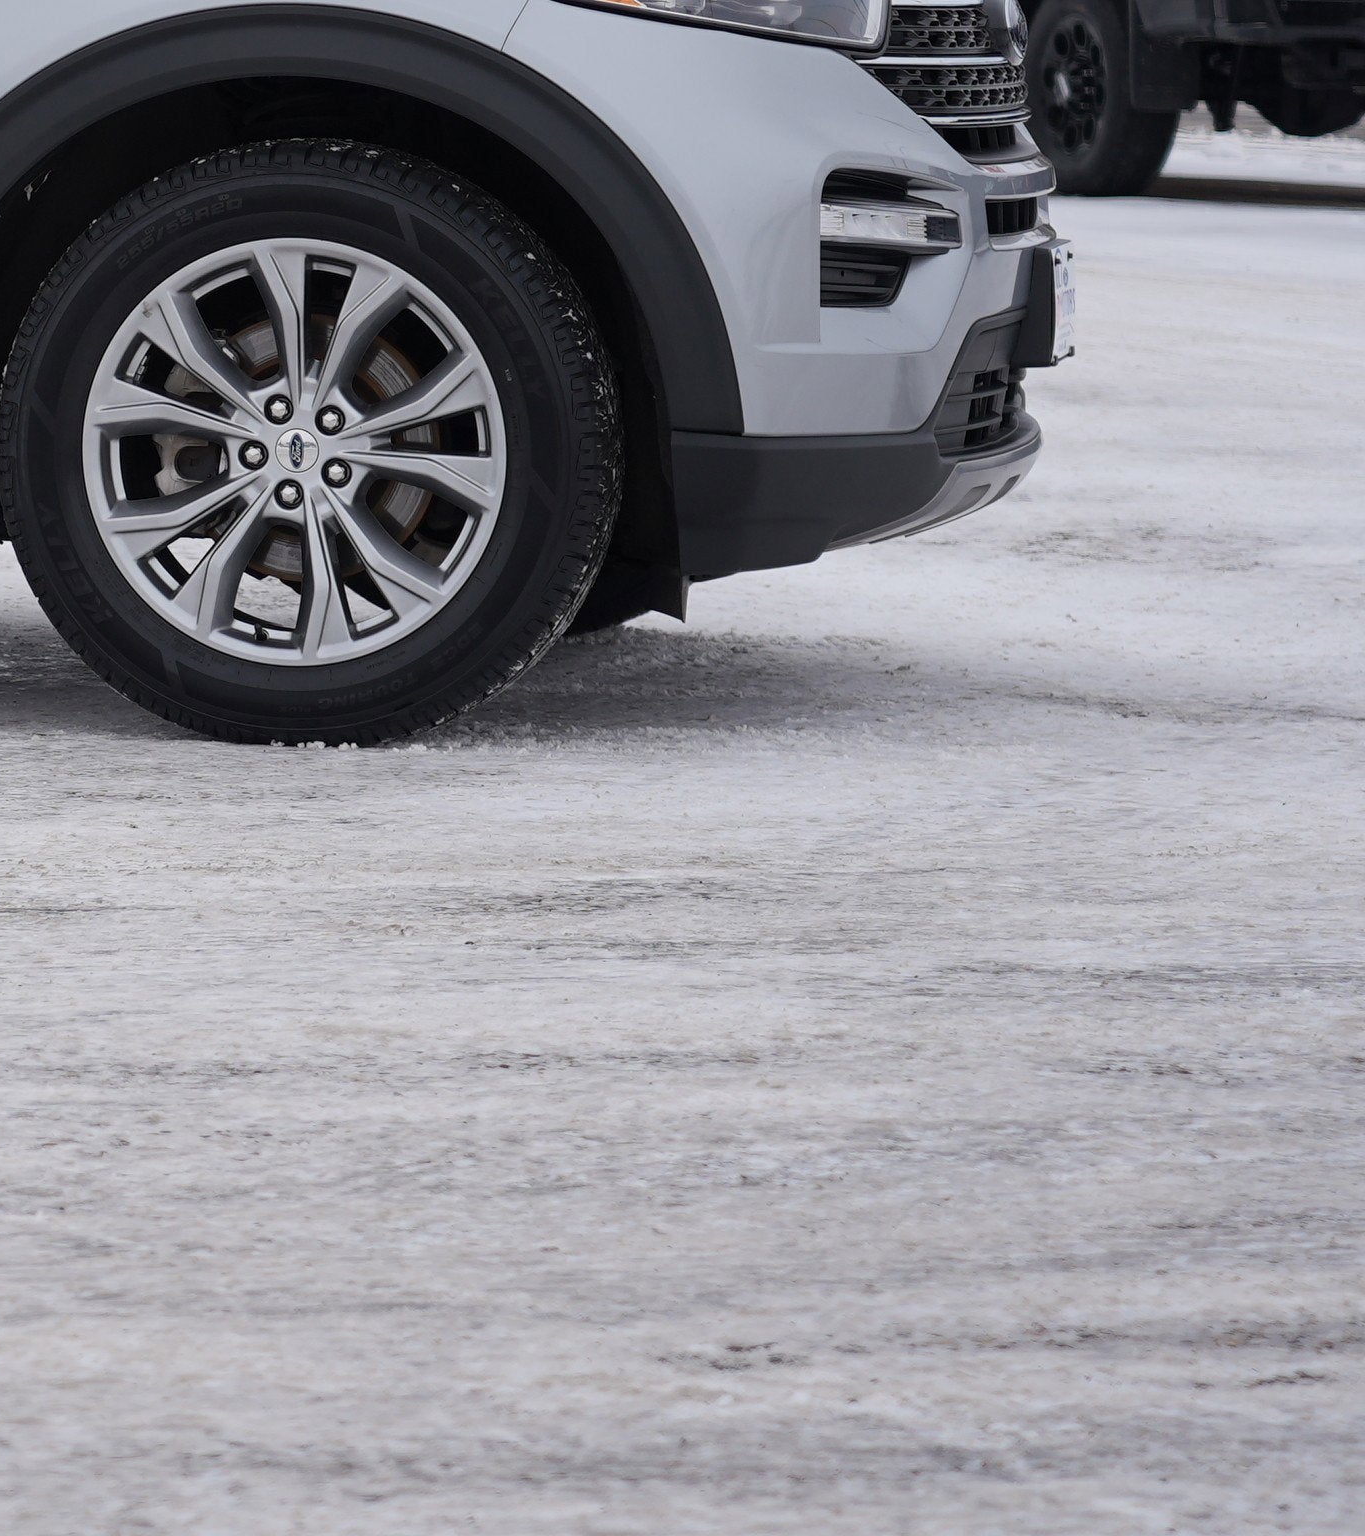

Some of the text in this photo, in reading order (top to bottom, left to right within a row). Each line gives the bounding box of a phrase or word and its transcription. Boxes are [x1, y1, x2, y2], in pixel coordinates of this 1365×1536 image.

[117, 198, 243, 270] 255/55R20
[472, 277, 547, 402] KELLY
[290, 436, 303, 464] Ford
[38, 499, 113, 625] KELLY
[317, 671, 418, 710] TOURING
